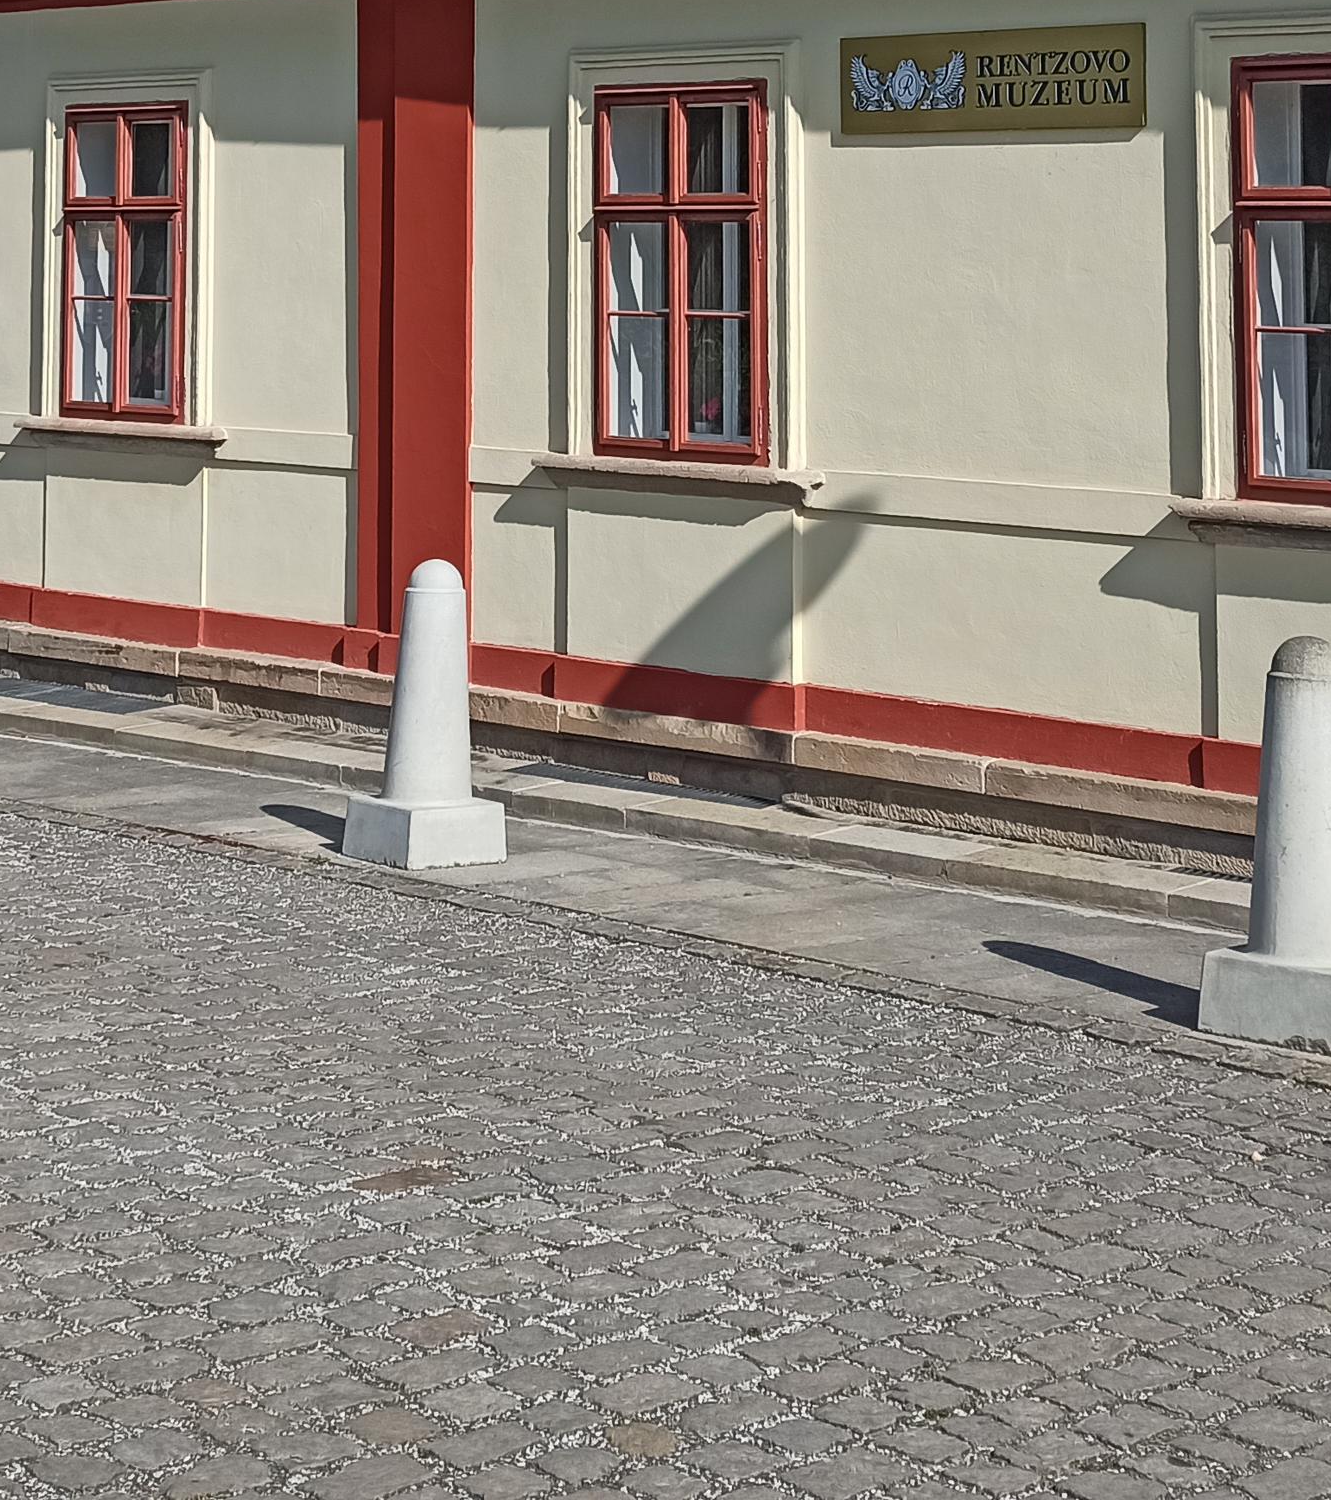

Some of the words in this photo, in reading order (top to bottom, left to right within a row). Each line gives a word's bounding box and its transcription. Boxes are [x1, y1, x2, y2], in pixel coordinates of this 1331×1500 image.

[975, 49, 1131, 78] RENTZOVO
[897, 73, 915, 97] R
[975, 78, 1131, 108] MUZEUM
